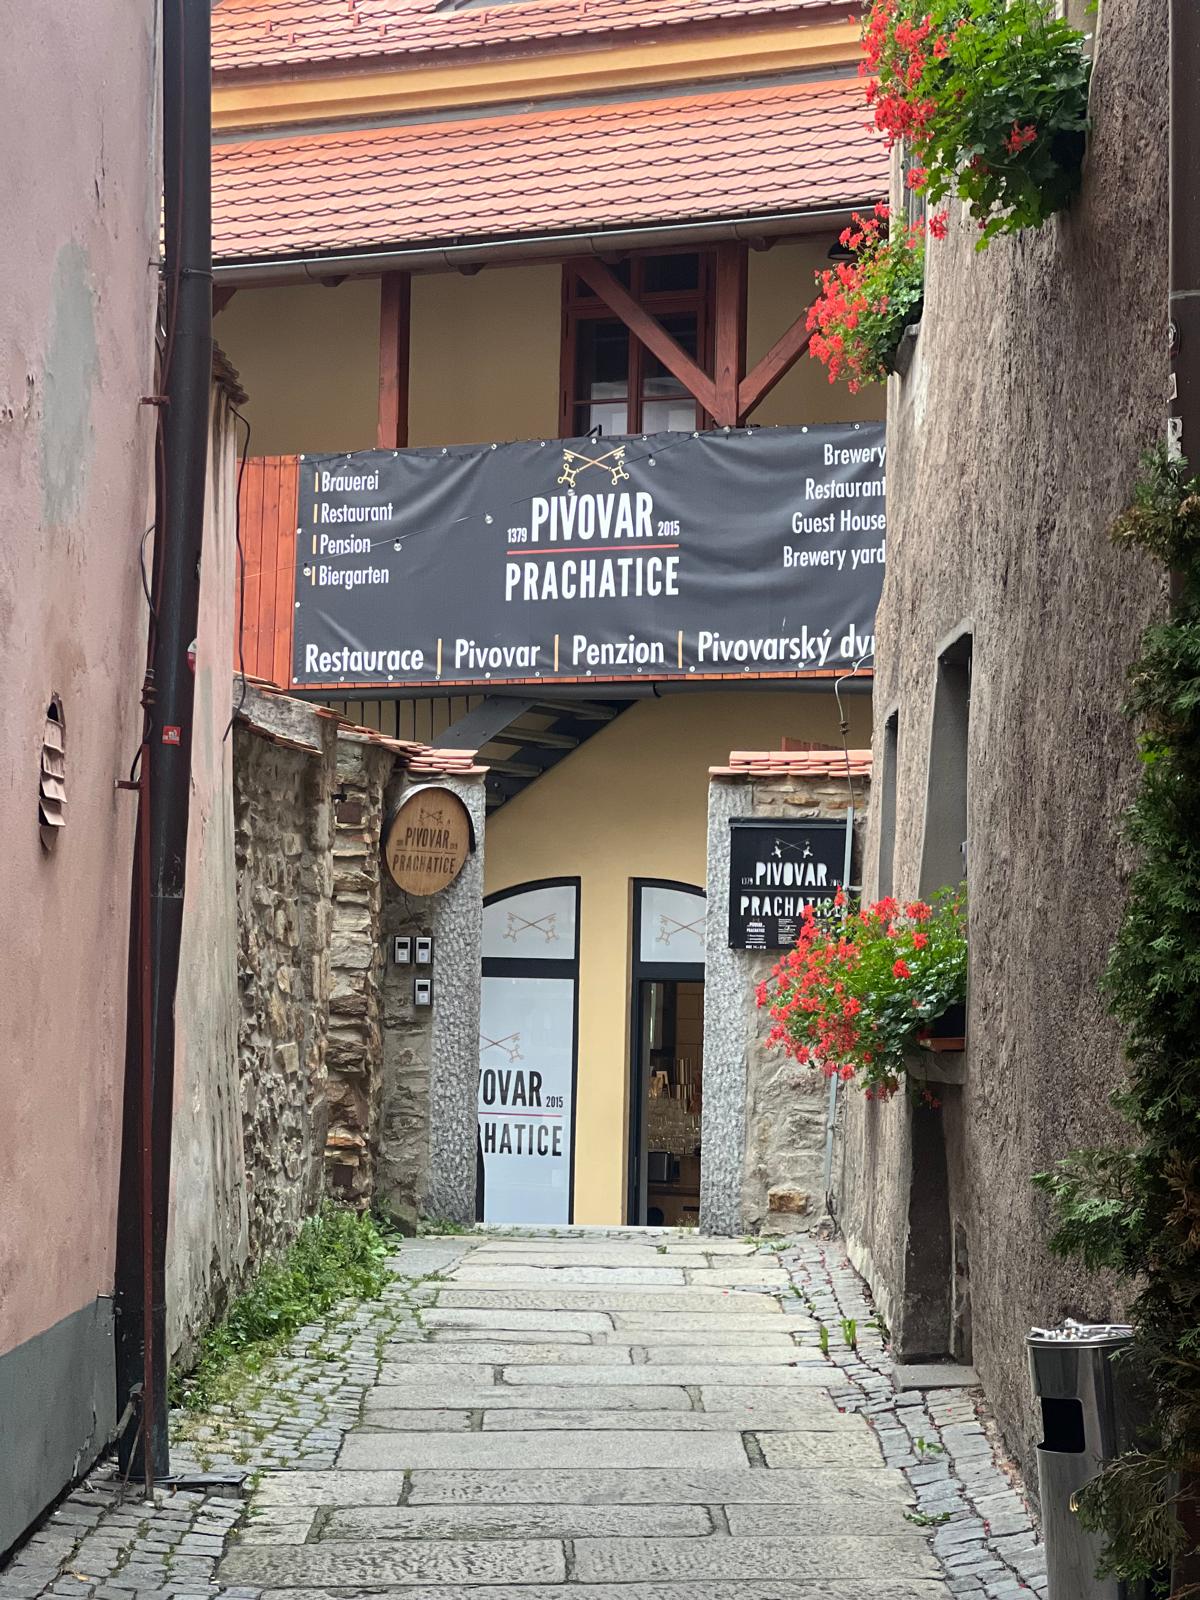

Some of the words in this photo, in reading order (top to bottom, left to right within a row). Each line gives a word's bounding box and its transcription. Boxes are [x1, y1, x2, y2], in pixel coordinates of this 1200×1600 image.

[824, 443, 886, 468] Brewery
[321, 470, 379, 492] Brauerei
[805, 476, 886, 500] Restaurant
[320, 502, 393, 523] Restaurant
[507, 527, 528, 543] 1379
[531, 492, 653, 543] PIVOVAR
[657, 520, 680, 537] 2015
[792, 511, 835, 534] Guest
[840, 509, 886, 532] House
[320, 534, 371, 554] Pension
[783, 545, 846, 571] Brewery
[851, 539, 886, 571] yard
[319, 566, 389, 590] Biergarten
[505, 556, 680, 601] PRACHATICE
[305, 643, 424, 673] Restaurace
[455, 639, 541, 669] Pivovar
[572, 634, 664, 666] Penzion
[698, 624, 832, 667] Pivovarský
[405, 827, 450, 849] PIVOVAR
[392, 854, 456, 874] PRACHATICE
[755, 862, 828, 887] PIVOVAR
[545, 1095, 564, 1108] 2015
